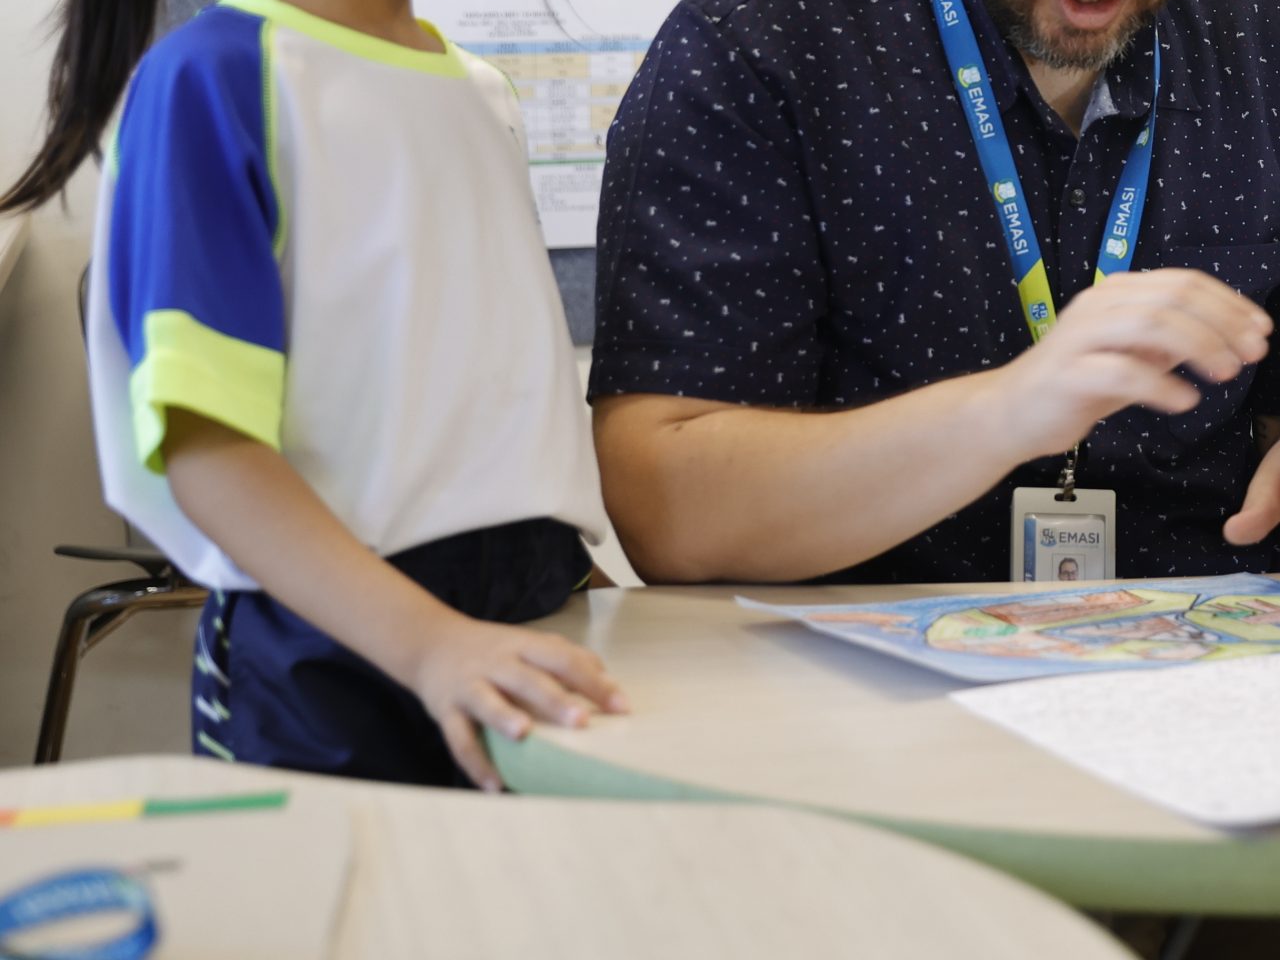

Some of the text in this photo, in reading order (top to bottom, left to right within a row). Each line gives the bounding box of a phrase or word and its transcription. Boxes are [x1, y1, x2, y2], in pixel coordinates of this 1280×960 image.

[967, 86, 996, 139] EMASI
[1004, 202, 1030, 257] EMASI
[1112, 186, 1136, 238] EMASI
[1058, 531, 1100, 545] EMASI
